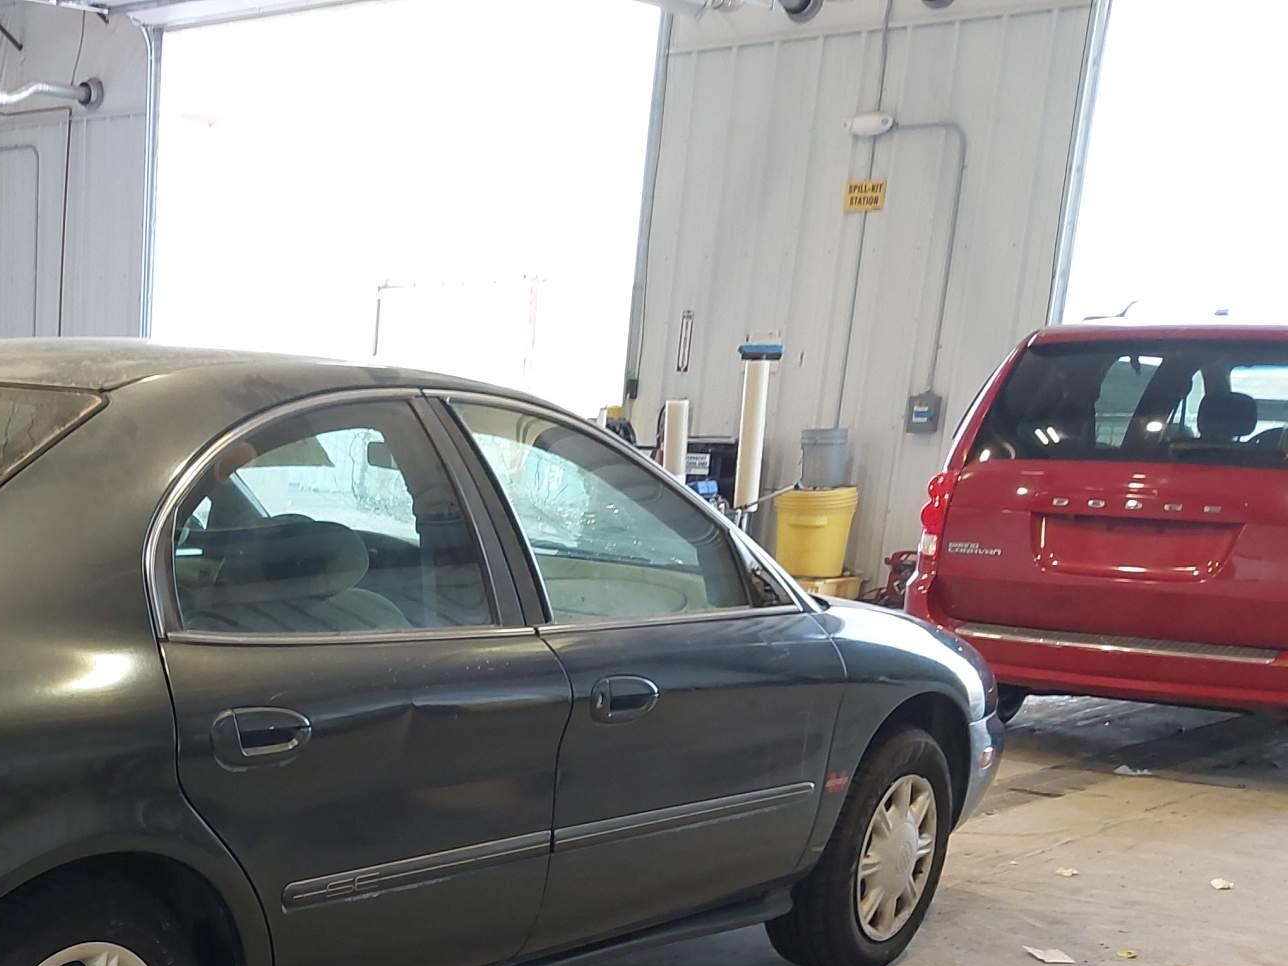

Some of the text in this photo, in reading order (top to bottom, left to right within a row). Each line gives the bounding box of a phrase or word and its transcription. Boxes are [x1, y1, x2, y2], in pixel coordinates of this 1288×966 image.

[848, 183, 884, 194] SPILL-KIT
[849, 195, 879, 207] STATION
[1051, 496, 1223, 514] DODGE
